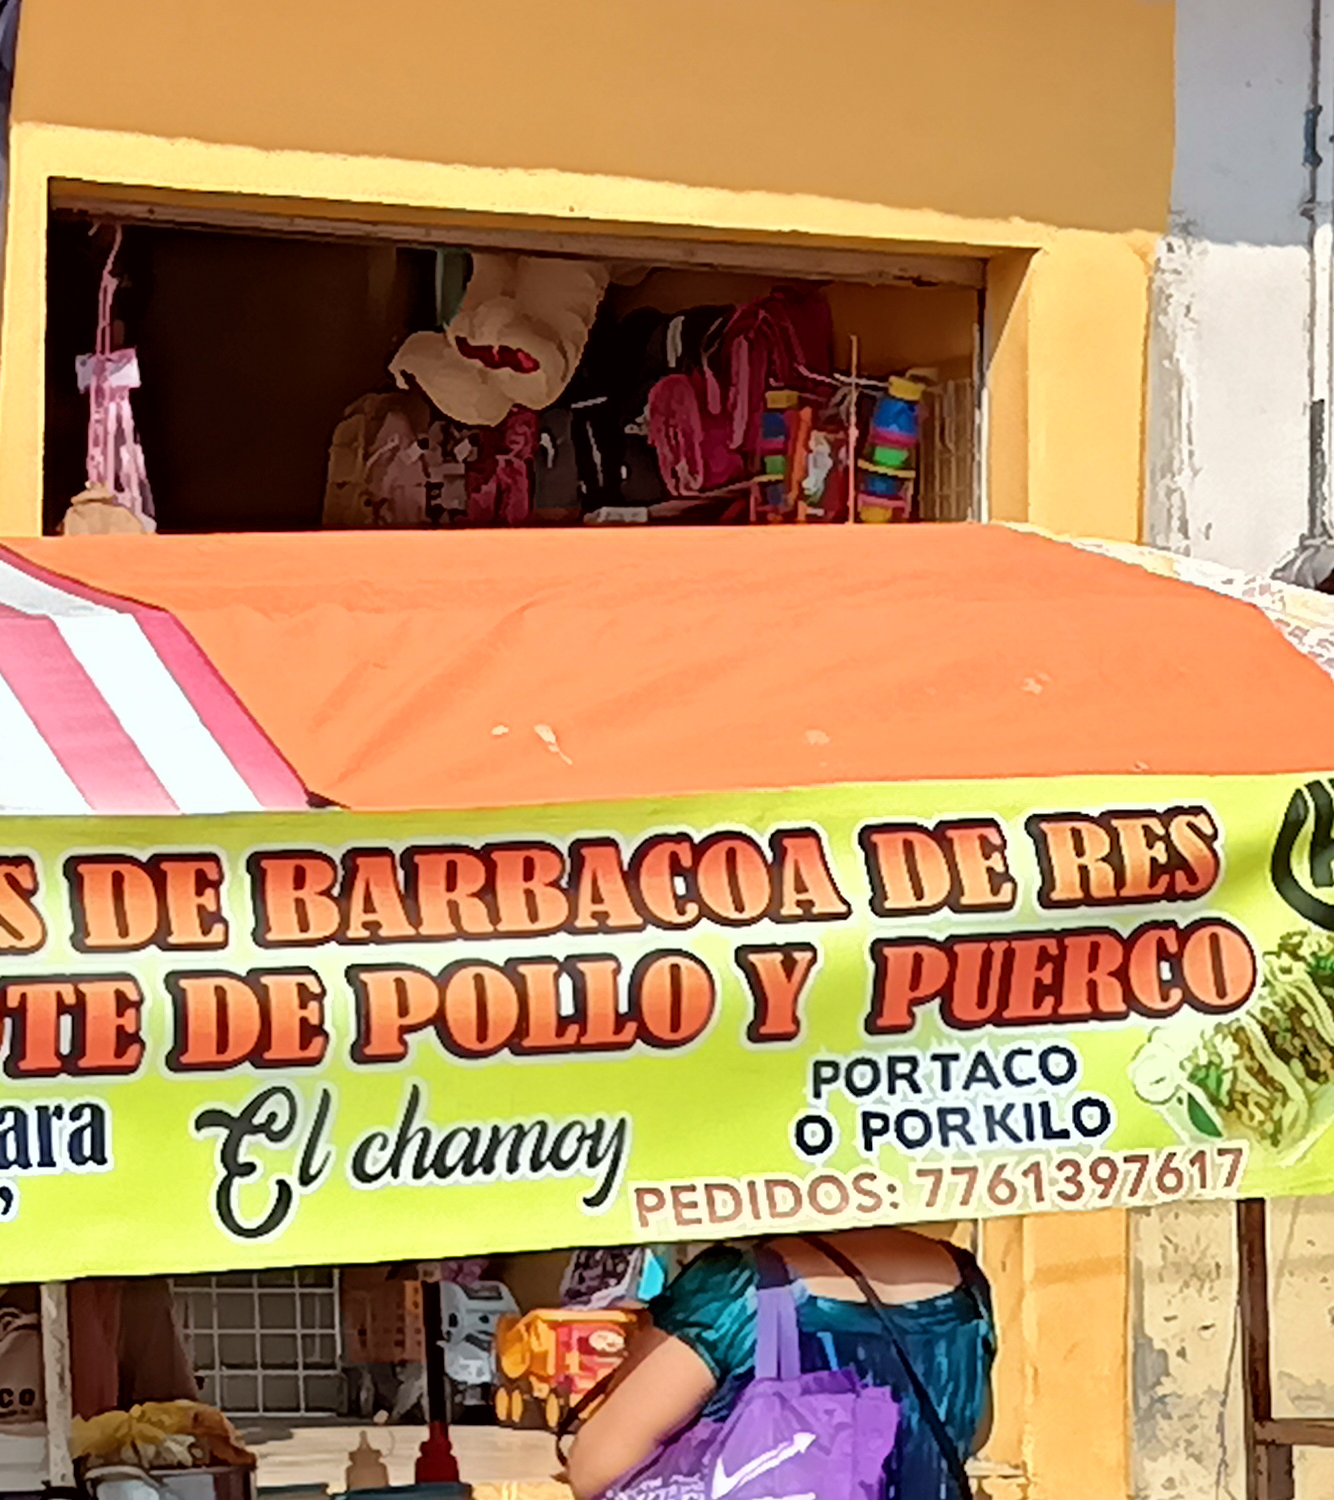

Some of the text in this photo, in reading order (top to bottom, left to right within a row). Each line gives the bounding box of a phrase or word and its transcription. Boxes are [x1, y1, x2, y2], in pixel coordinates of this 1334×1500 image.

[65, 850, 230, 955] DE
[249, 828, 851, 948] BARBACOA
[858, 817, 1018, 918] DE
[1025, 805, 1220, 909] RES
[166, 965, 328, 1070] DE
[346, 948, 717, 1065] POLLO
[735, 944, 817, 1043] Y
[864, 916, 1257, 1036] PUERCO
[194, 1083, 628, 1240] El chamoy
[633, 1147, 1243, 1228] PEDIDOS: 7761397617
[794, 1114, 834, 1156] O
